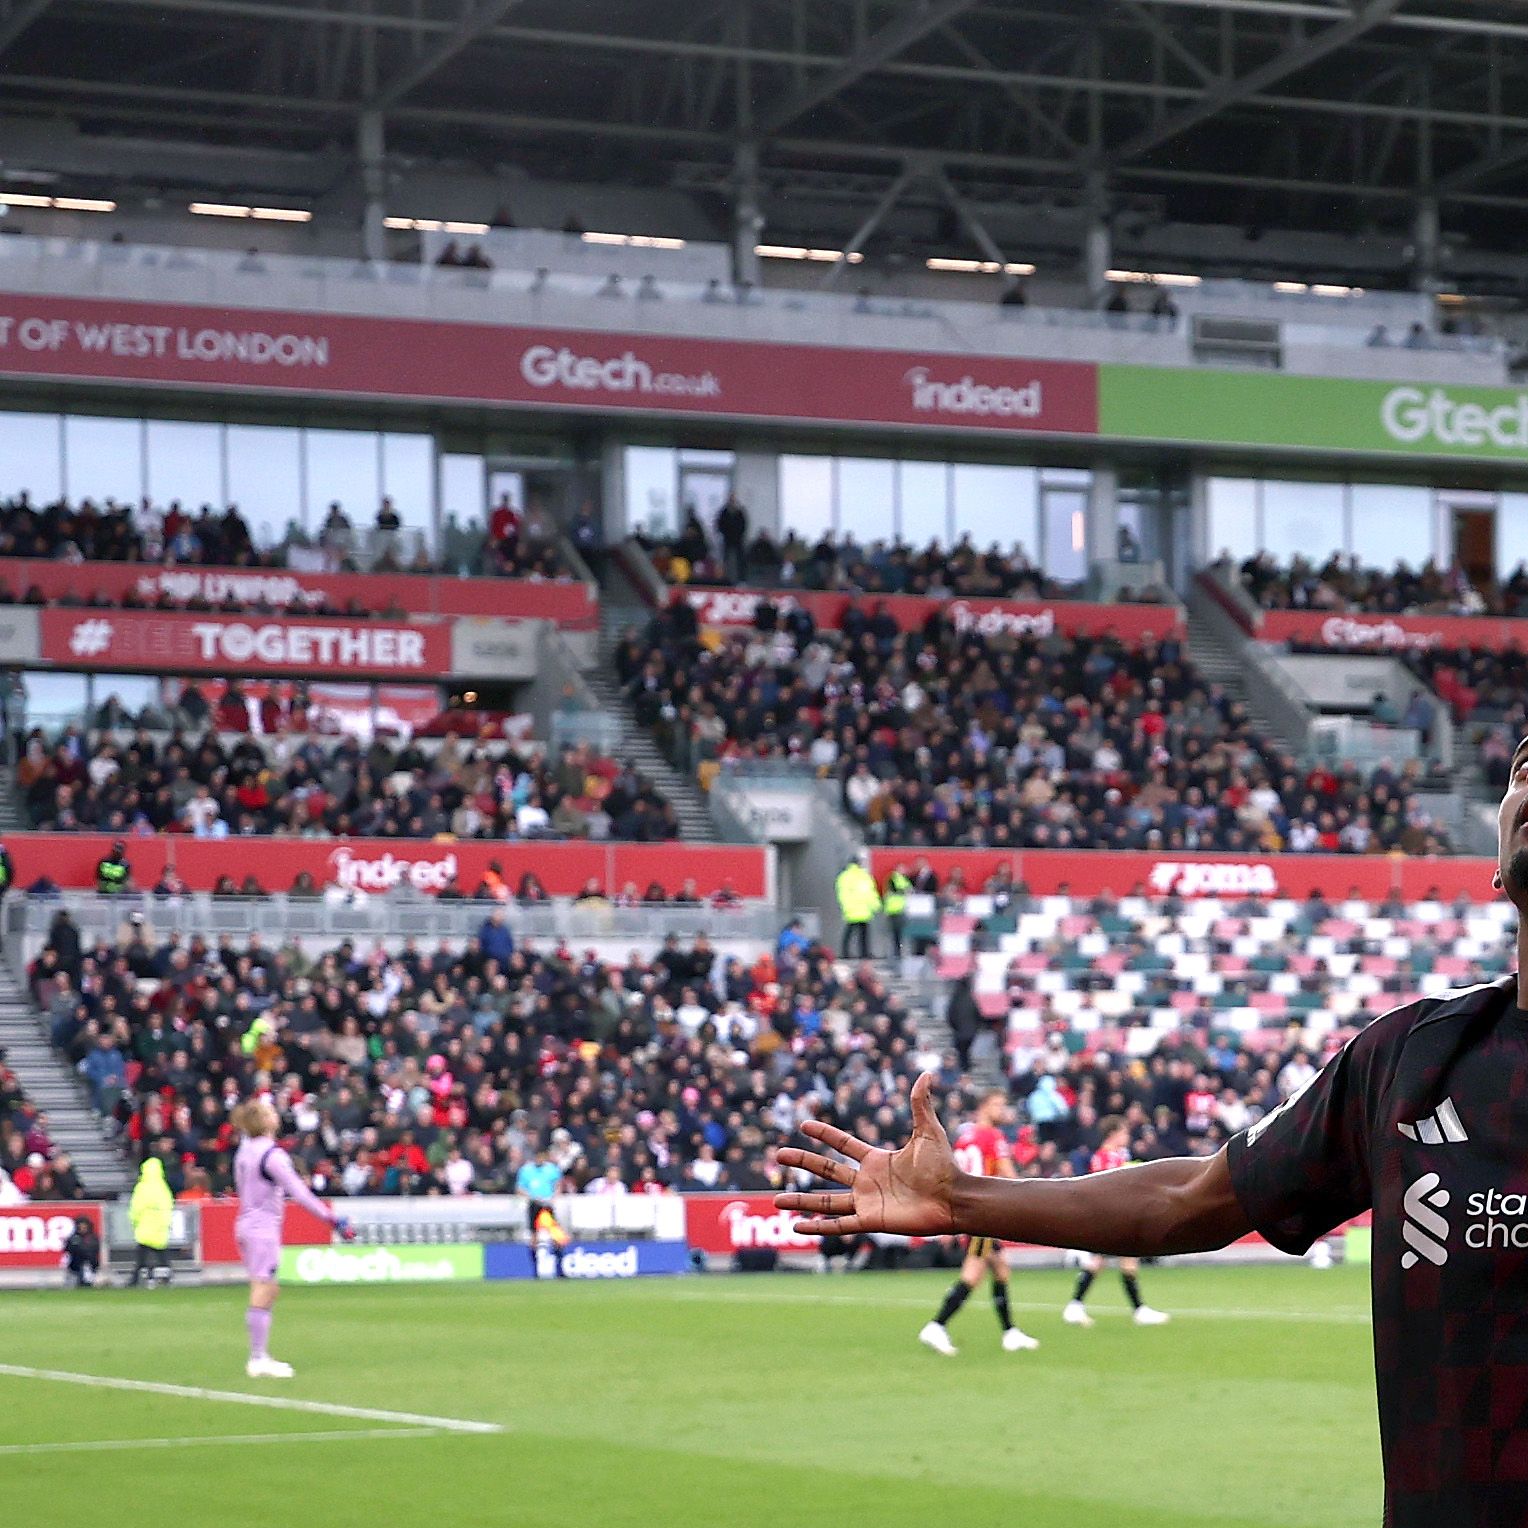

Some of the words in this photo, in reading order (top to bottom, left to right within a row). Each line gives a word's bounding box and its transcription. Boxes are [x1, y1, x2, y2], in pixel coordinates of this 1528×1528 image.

[18, 318, 69, 350] OF
[76, 321, 172, 357] WEST
[177, 327, 330, 367] LONDON
[904, 366, 1042, 417] indeed
